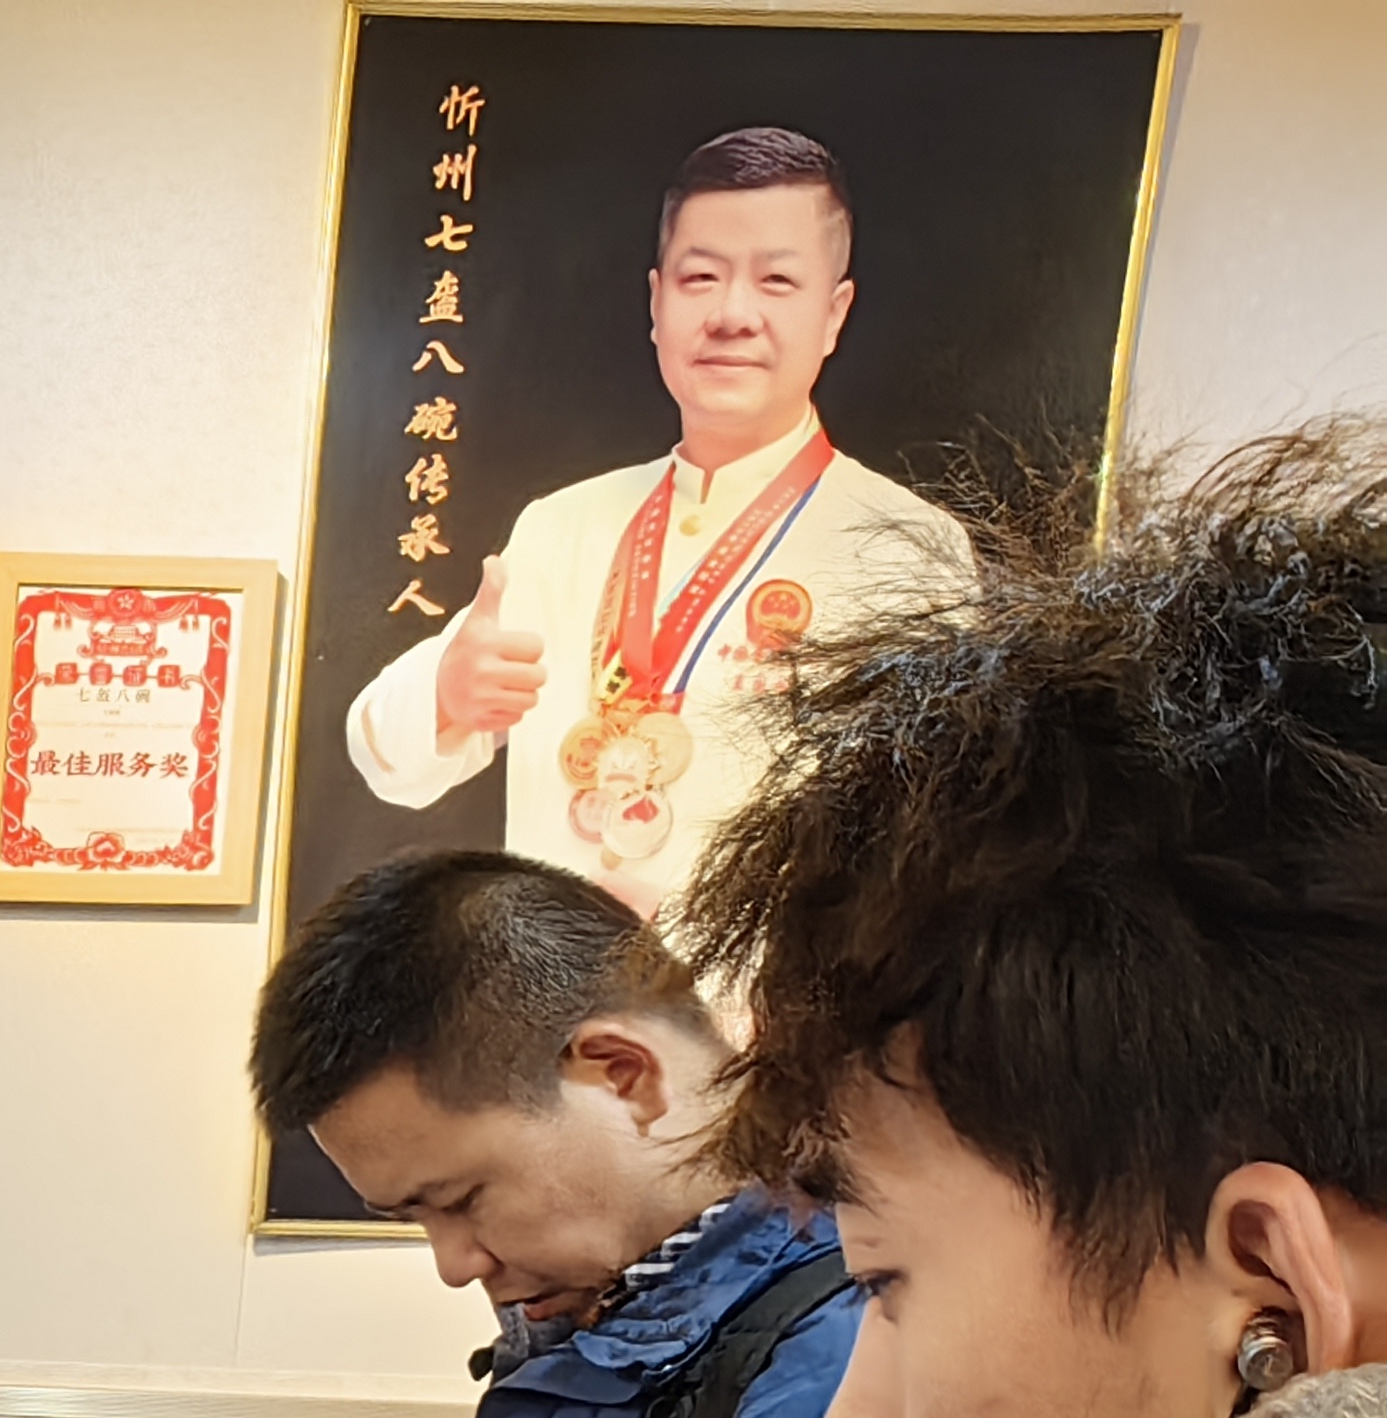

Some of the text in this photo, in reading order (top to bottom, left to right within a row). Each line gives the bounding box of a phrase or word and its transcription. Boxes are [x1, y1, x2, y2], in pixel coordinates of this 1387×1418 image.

[388, 84, 485, 616] 忻州七盔八碗传承人
[30, 750, 190, 779] 最佳服务奖
